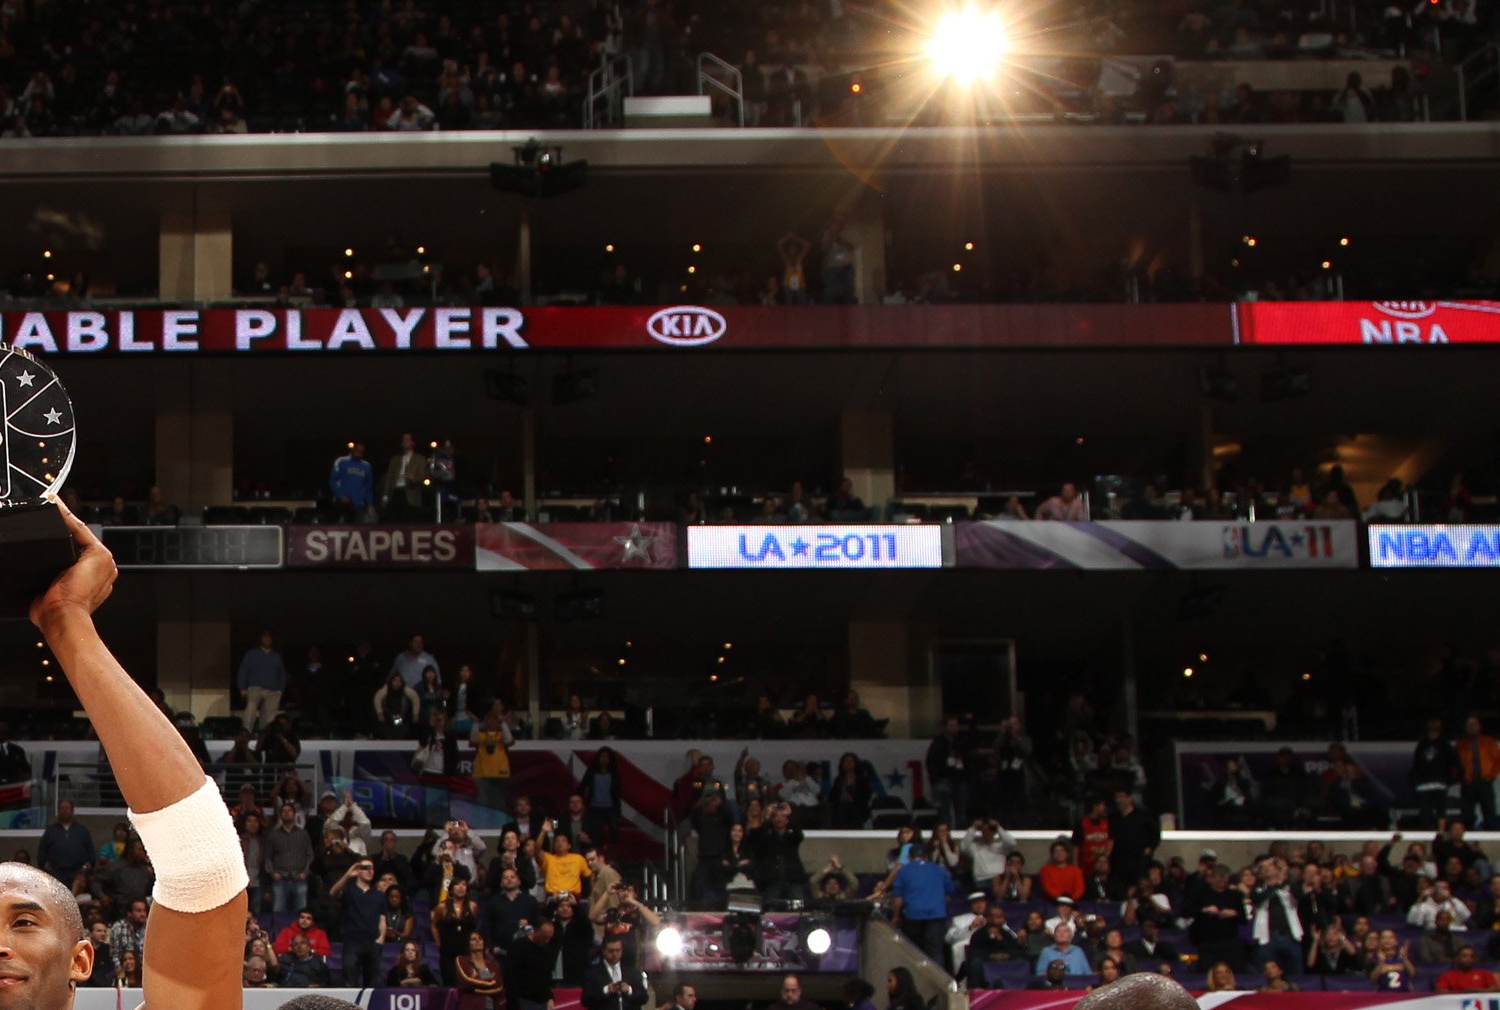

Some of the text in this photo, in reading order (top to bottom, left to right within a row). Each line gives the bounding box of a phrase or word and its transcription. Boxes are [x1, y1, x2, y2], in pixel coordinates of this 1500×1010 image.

[235, 307, 528, 350] PLAYER
[661, 314, 714, 337] KIA
[1360, 318, 1449, 344] NBA
[305, 530, 457, 561] STAPLES
[739, 532, 897, 561] LA 2011
[1242, 526, 1334, 558] LA 11
[1380, 530, 1456, 560] NBA
[1387, 971, 1401, 988] 2
